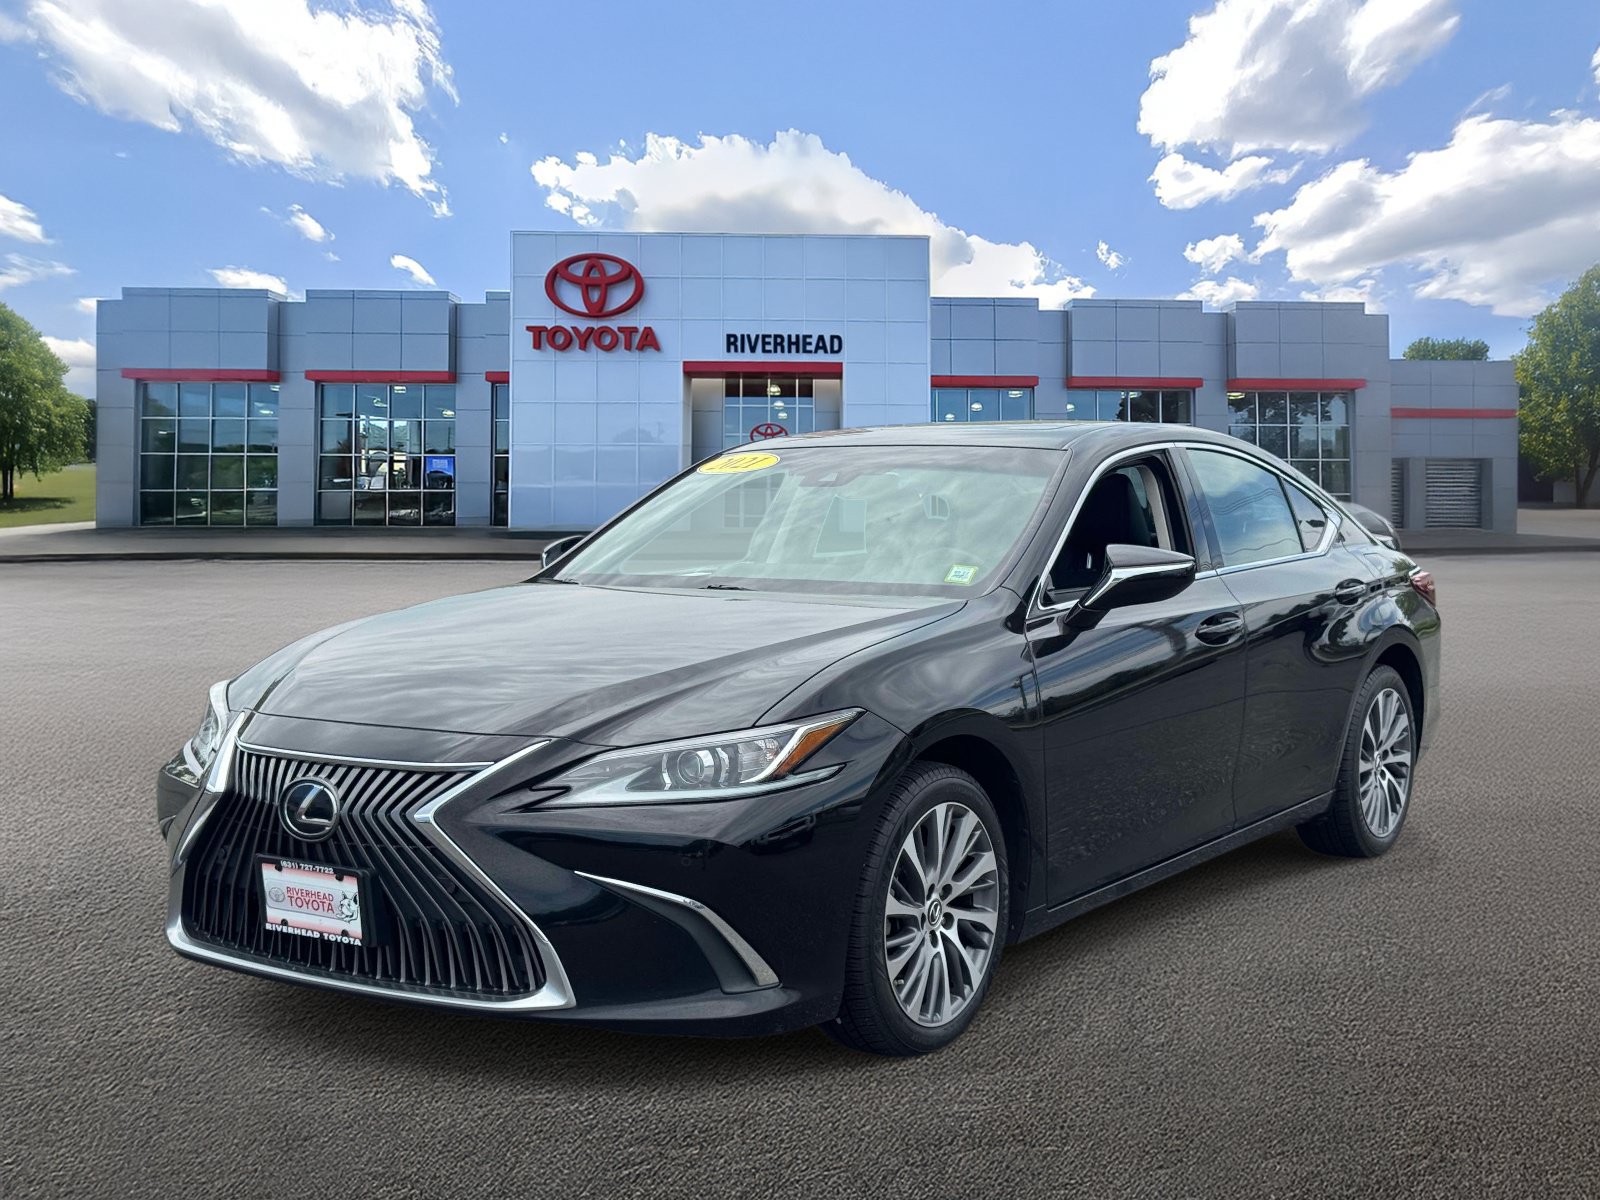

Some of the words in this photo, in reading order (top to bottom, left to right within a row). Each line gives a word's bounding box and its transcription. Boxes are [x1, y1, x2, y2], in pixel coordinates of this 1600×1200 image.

[525, 325, 661, 352] TOYOTA
[726, 333, 843, 354] RIVERHEAD
[300, 863, 335, 874] 727-7722
[286, 886, 334, 902] RIVERHEAD
[287, 895, 335, 914] TOYOTA
[265, 922, 321, 939] RIVERHEAD
[322, 933, 362, 946] TOYOTA
